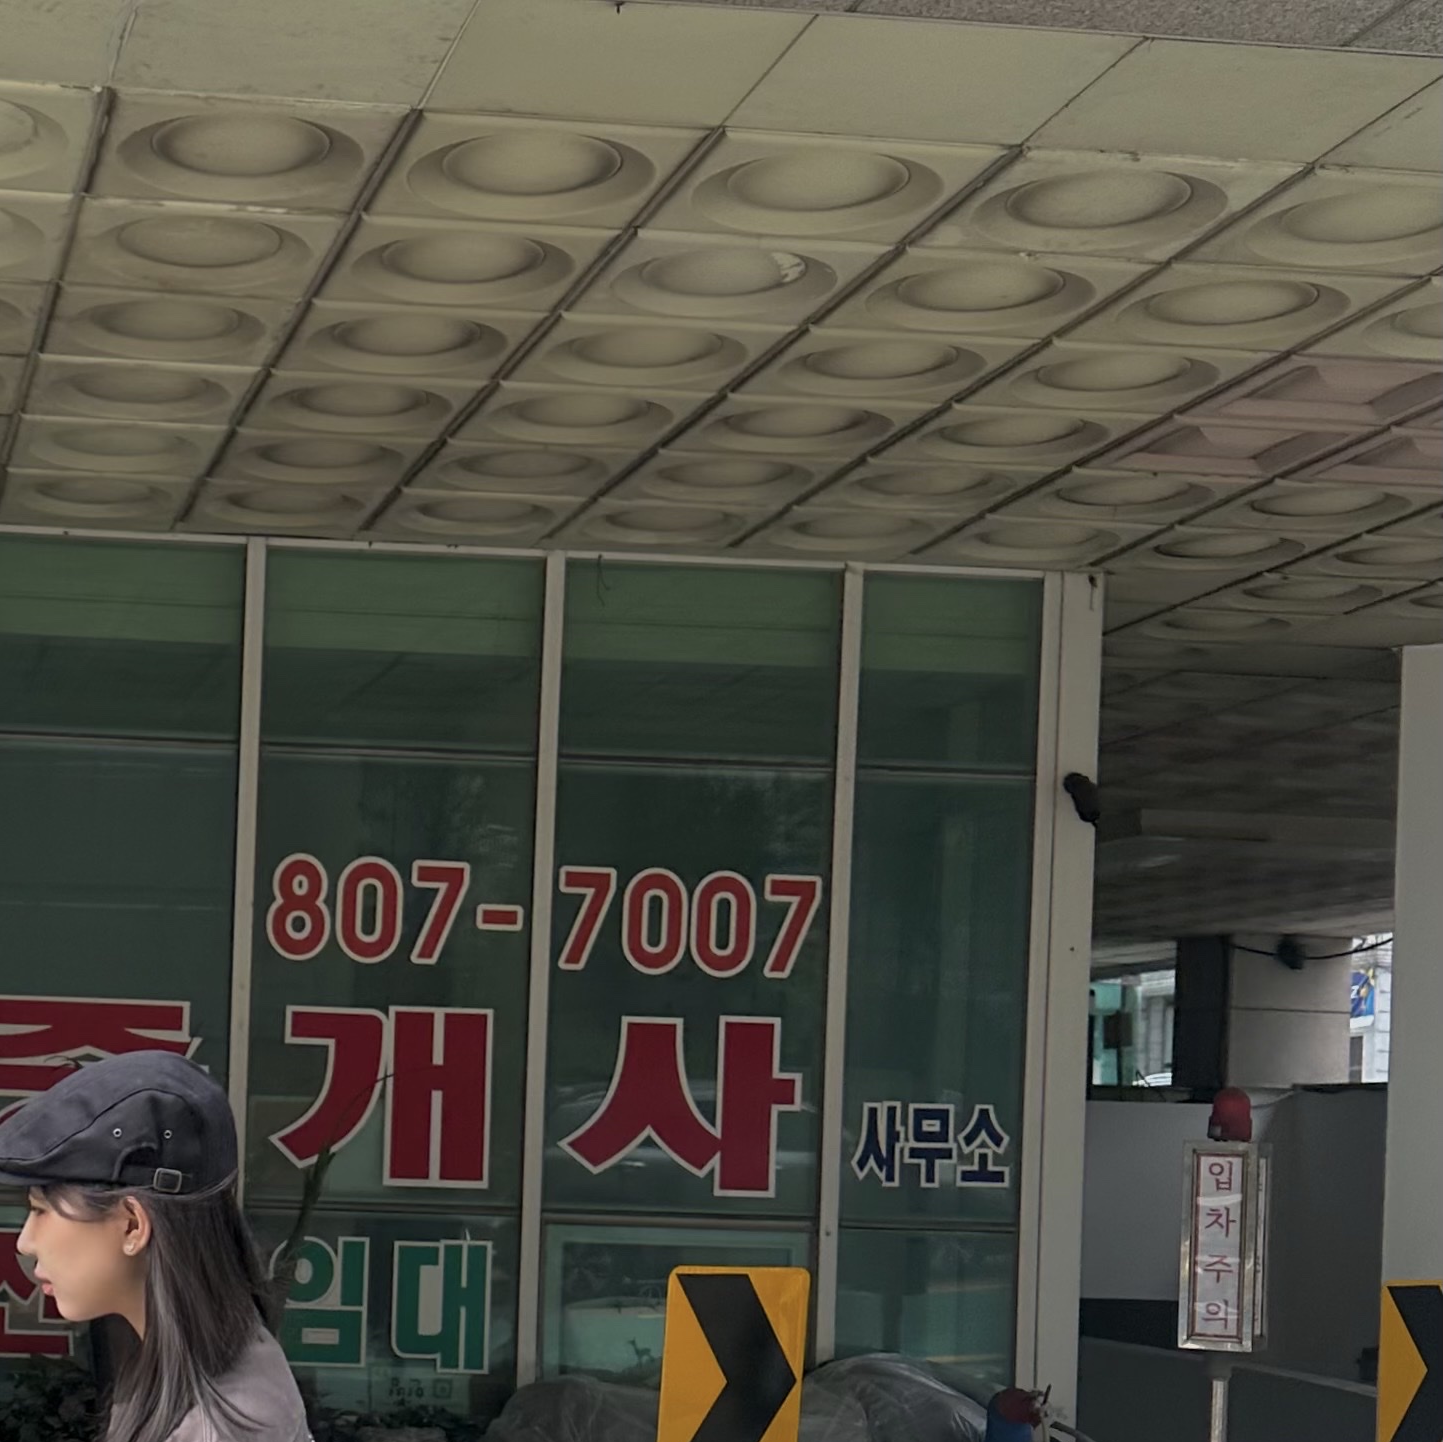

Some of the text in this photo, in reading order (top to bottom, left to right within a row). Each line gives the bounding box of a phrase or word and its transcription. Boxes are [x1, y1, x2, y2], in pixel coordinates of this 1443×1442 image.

[267, 853, 822, 979] 807-7007
[851, 1101, 1010, 1188] 사무소
[269, 1236, 493, 1374] 임대
[1201, 1160, 1237, 1330] 입차주의
